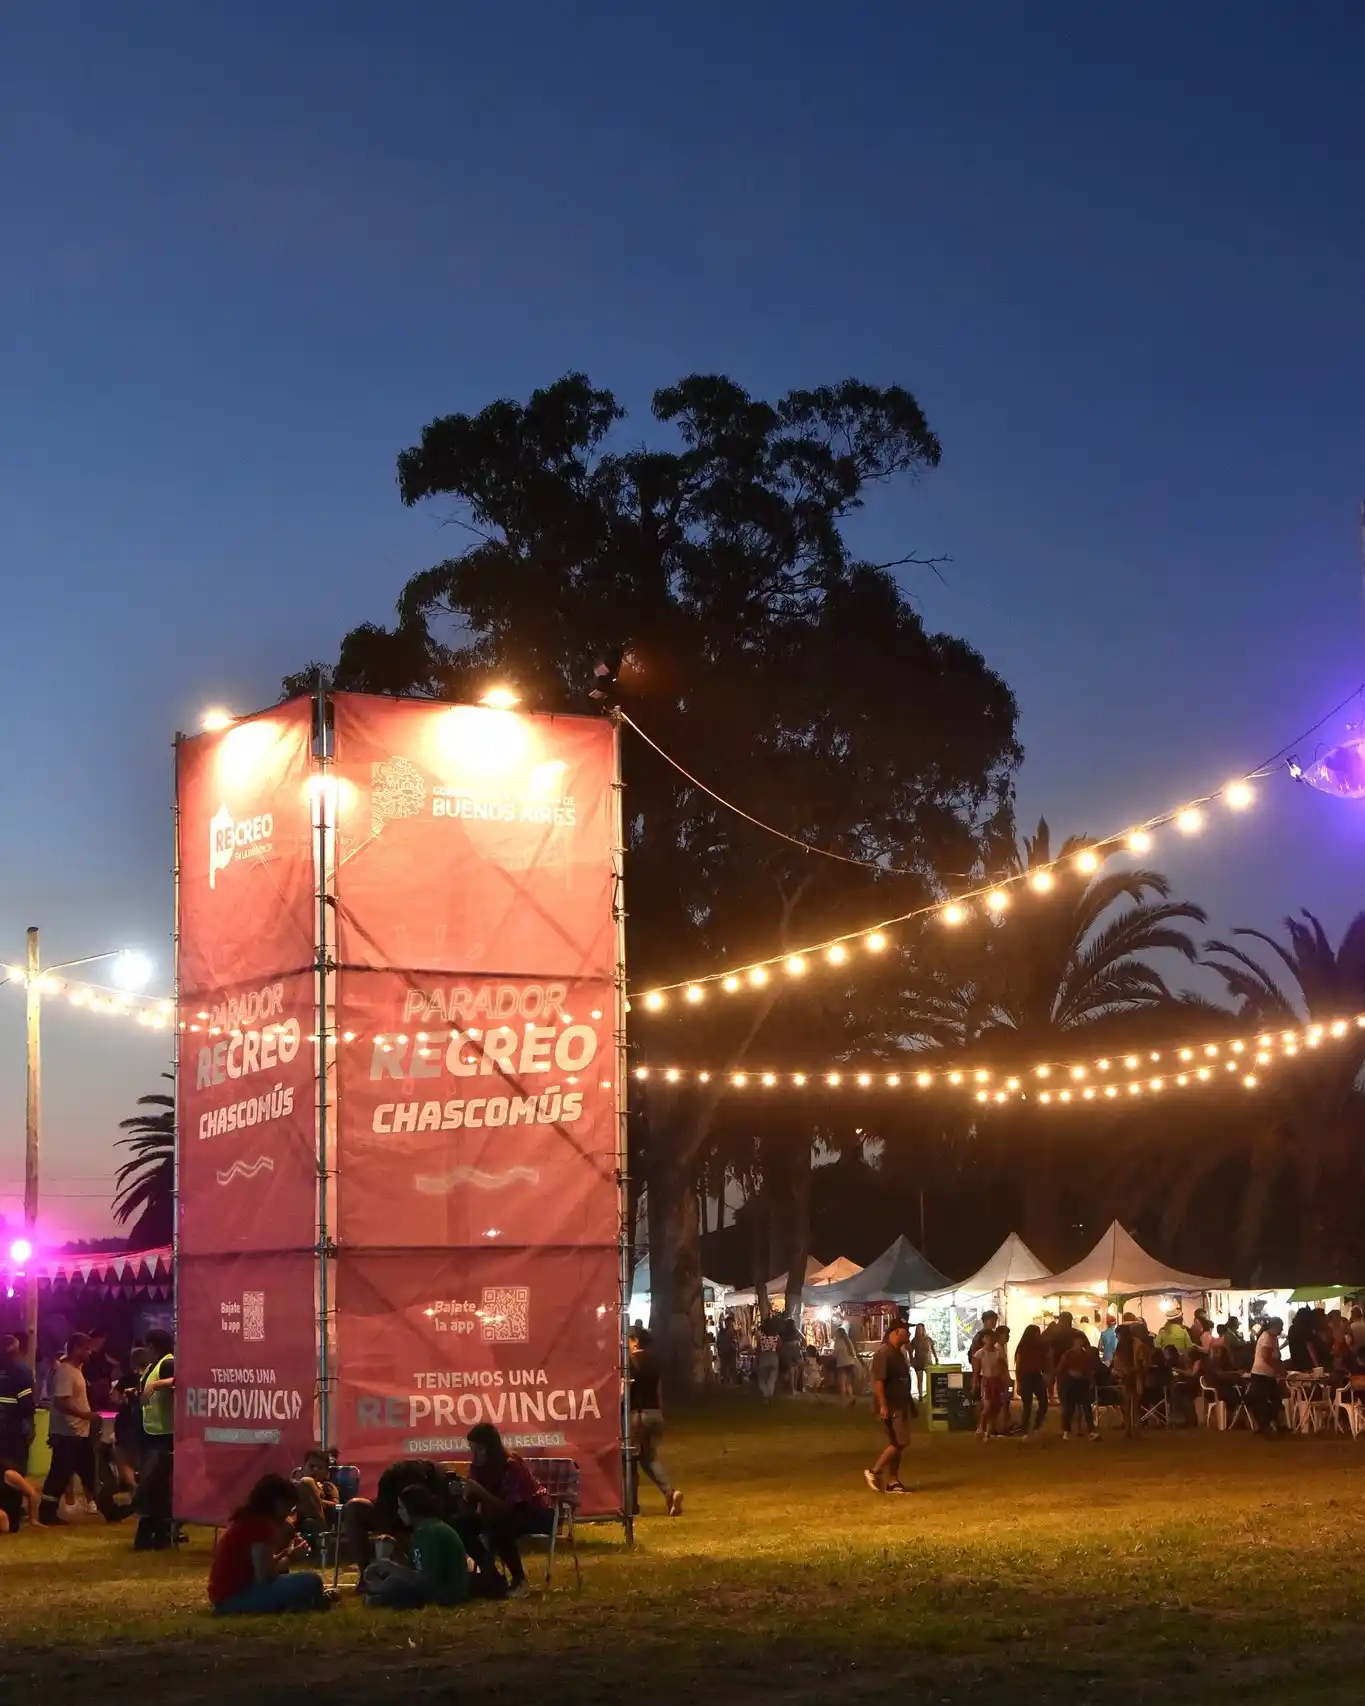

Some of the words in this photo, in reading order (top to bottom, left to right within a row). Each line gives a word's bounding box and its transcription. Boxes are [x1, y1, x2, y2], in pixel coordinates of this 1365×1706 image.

[432, 797, 515, 821] BUENOS
[520, 805, 576, 826] AIRES
[216, 813, 273, 853] RECREO
[209, 983, 283, 1038] PARADOR
[401, 984, 567, 1024] PARADOR
[196, 1017, 301, 1091] RECREO
[369, 1025, 598, 1081] RECREO
[199, 1082, 294, 1140] CHASCOMÚS
[372, 1085, 584, 1134] CHASCOMÚS
[220, 1301, 241, 1316] Bajate
[434, 1300, 477, 1316] Bajate
[221, 1318, 228, 1331] la
[228, 1320, 241, 1334] app
[435, 1318, 448, 1332] la
[450, 1320, 475, 1334] app
[211, 1368, 255, 1383] TENEMOS
[256, 1369, 276, 1384] UNA
[413, 1370, 504, 1389] TENEMOS
[508, 1369, 549, 1386] UNA
[186, 1387, 302, 1420] REPROVINCIA
[356, 1388, 601, 1430] REPROVINCIA
[515, 1433, 560, 1448] RECREO
